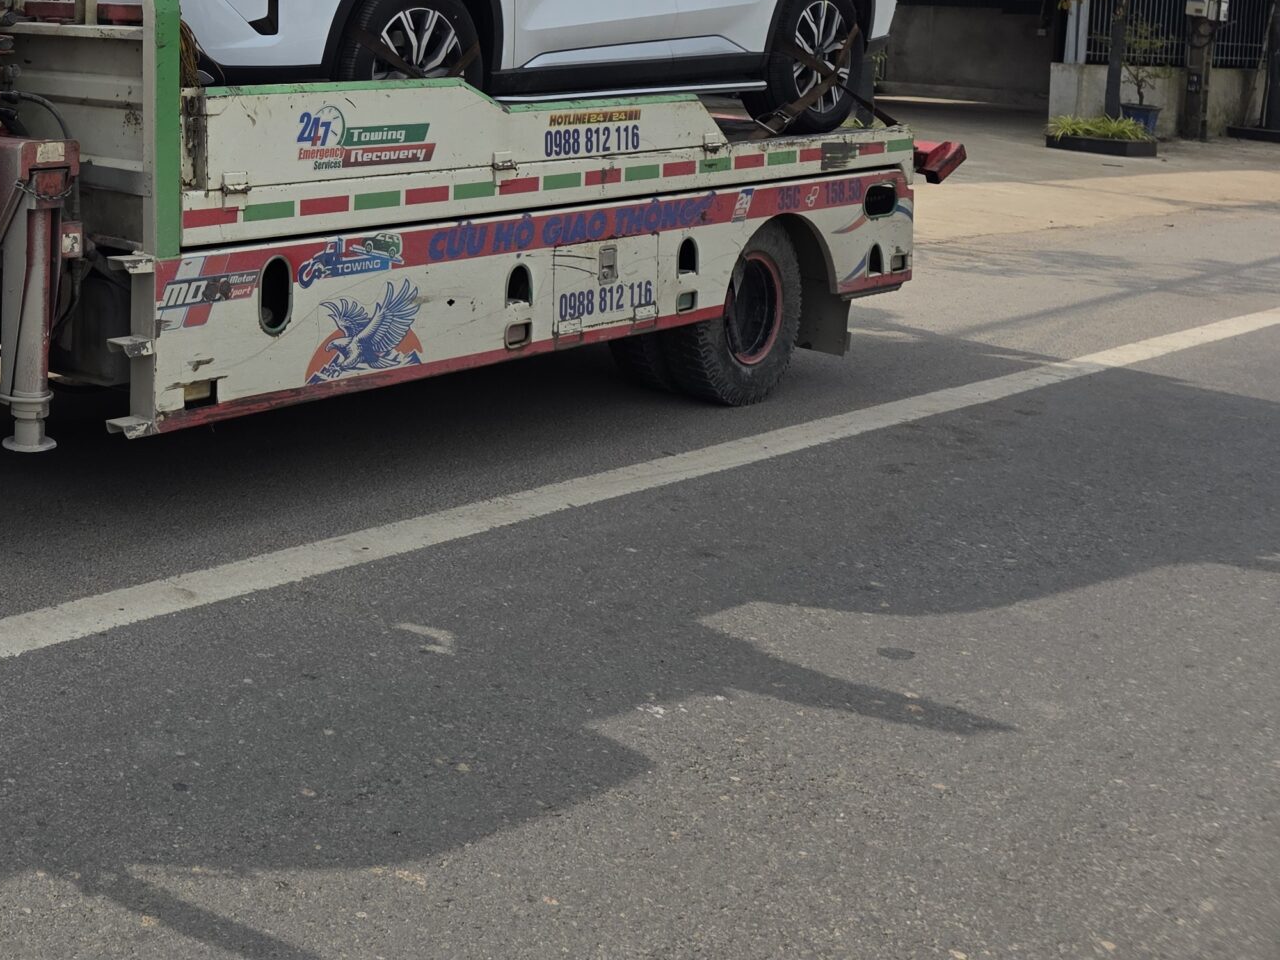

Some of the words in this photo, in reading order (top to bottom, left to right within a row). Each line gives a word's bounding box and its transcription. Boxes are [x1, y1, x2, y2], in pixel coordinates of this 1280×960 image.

[549, 113, 588, 126] HOTLINE
[350, 128, 406, 142] Towing
[545, 128, 580, 157] 0988
[585, 126, 610, 153] 812
[615, 124, 640, 150] 116
[298, 147, 346, 160] Emergency
[350, 148, 426, 162] Recovery
[313, 160, 342, 170] Services
[542, 211, 608, 246] GIAO
[337, 259, 381, 273] TOWING
[229, 274, 256, 284] Motor
[560, 289, 595, 320] 0988
[599, 284, 624, 313] 812
[629, 280, 653, 307] 116
